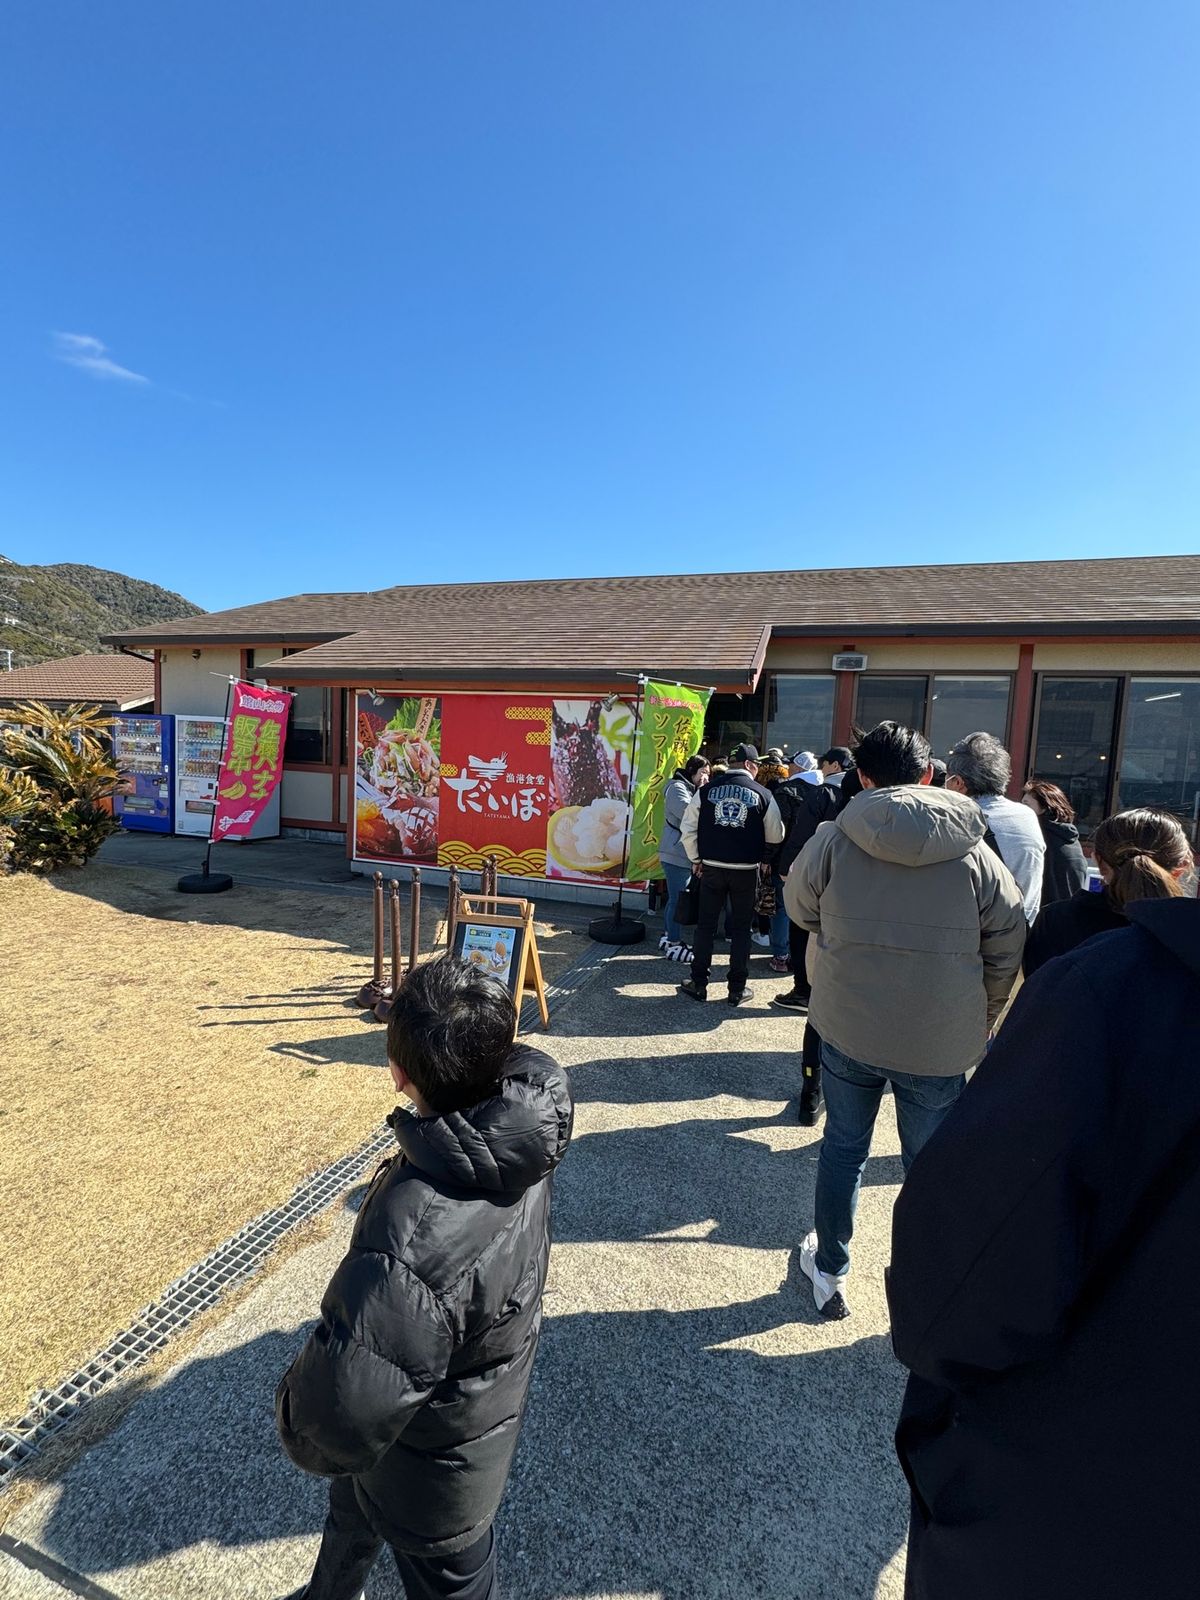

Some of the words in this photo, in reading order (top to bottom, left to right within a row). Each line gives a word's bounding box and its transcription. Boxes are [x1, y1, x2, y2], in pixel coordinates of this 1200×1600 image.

[227, 715, 260, 776] 販売中
[442, 768, 546, 821] だいぼ
[506, 773, 546, 785] 漁港食堂
[642, 712, 670, 846] ソフトクリーム
